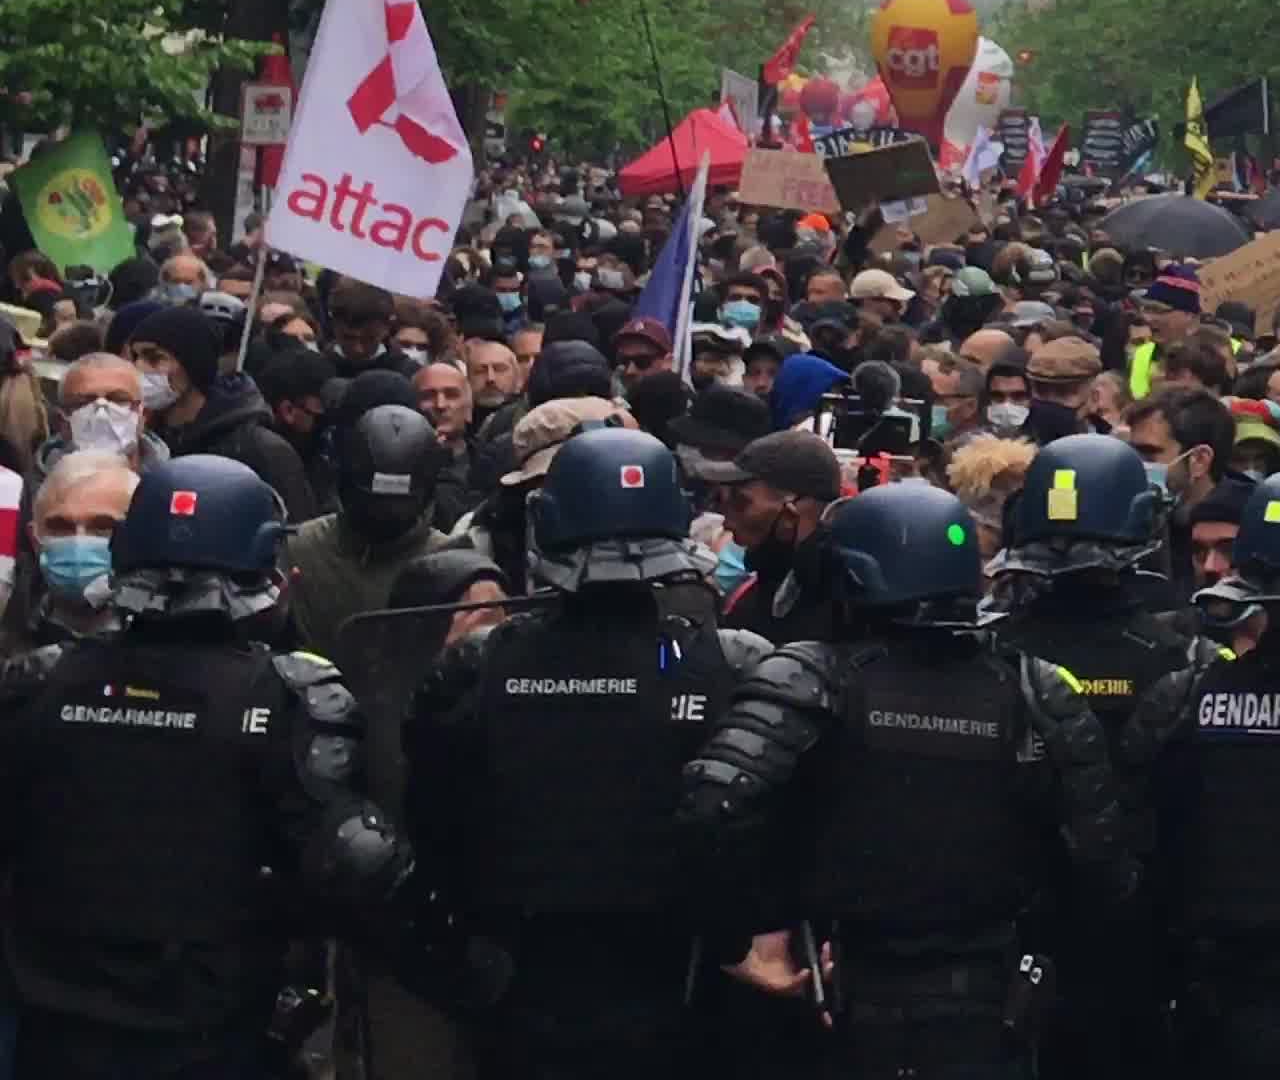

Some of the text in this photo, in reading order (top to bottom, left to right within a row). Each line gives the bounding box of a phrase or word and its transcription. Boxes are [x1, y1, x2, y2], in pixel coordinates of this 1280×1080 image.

[888, 46, 940, 77] cgt
[287, 173, 450, 262] attac
[505, 679, 638, 695] GENDARMERIE
[60, 704, 197, 729] GENDARMERIE
[868, 710, 1000, 738] GENDARMERIE
